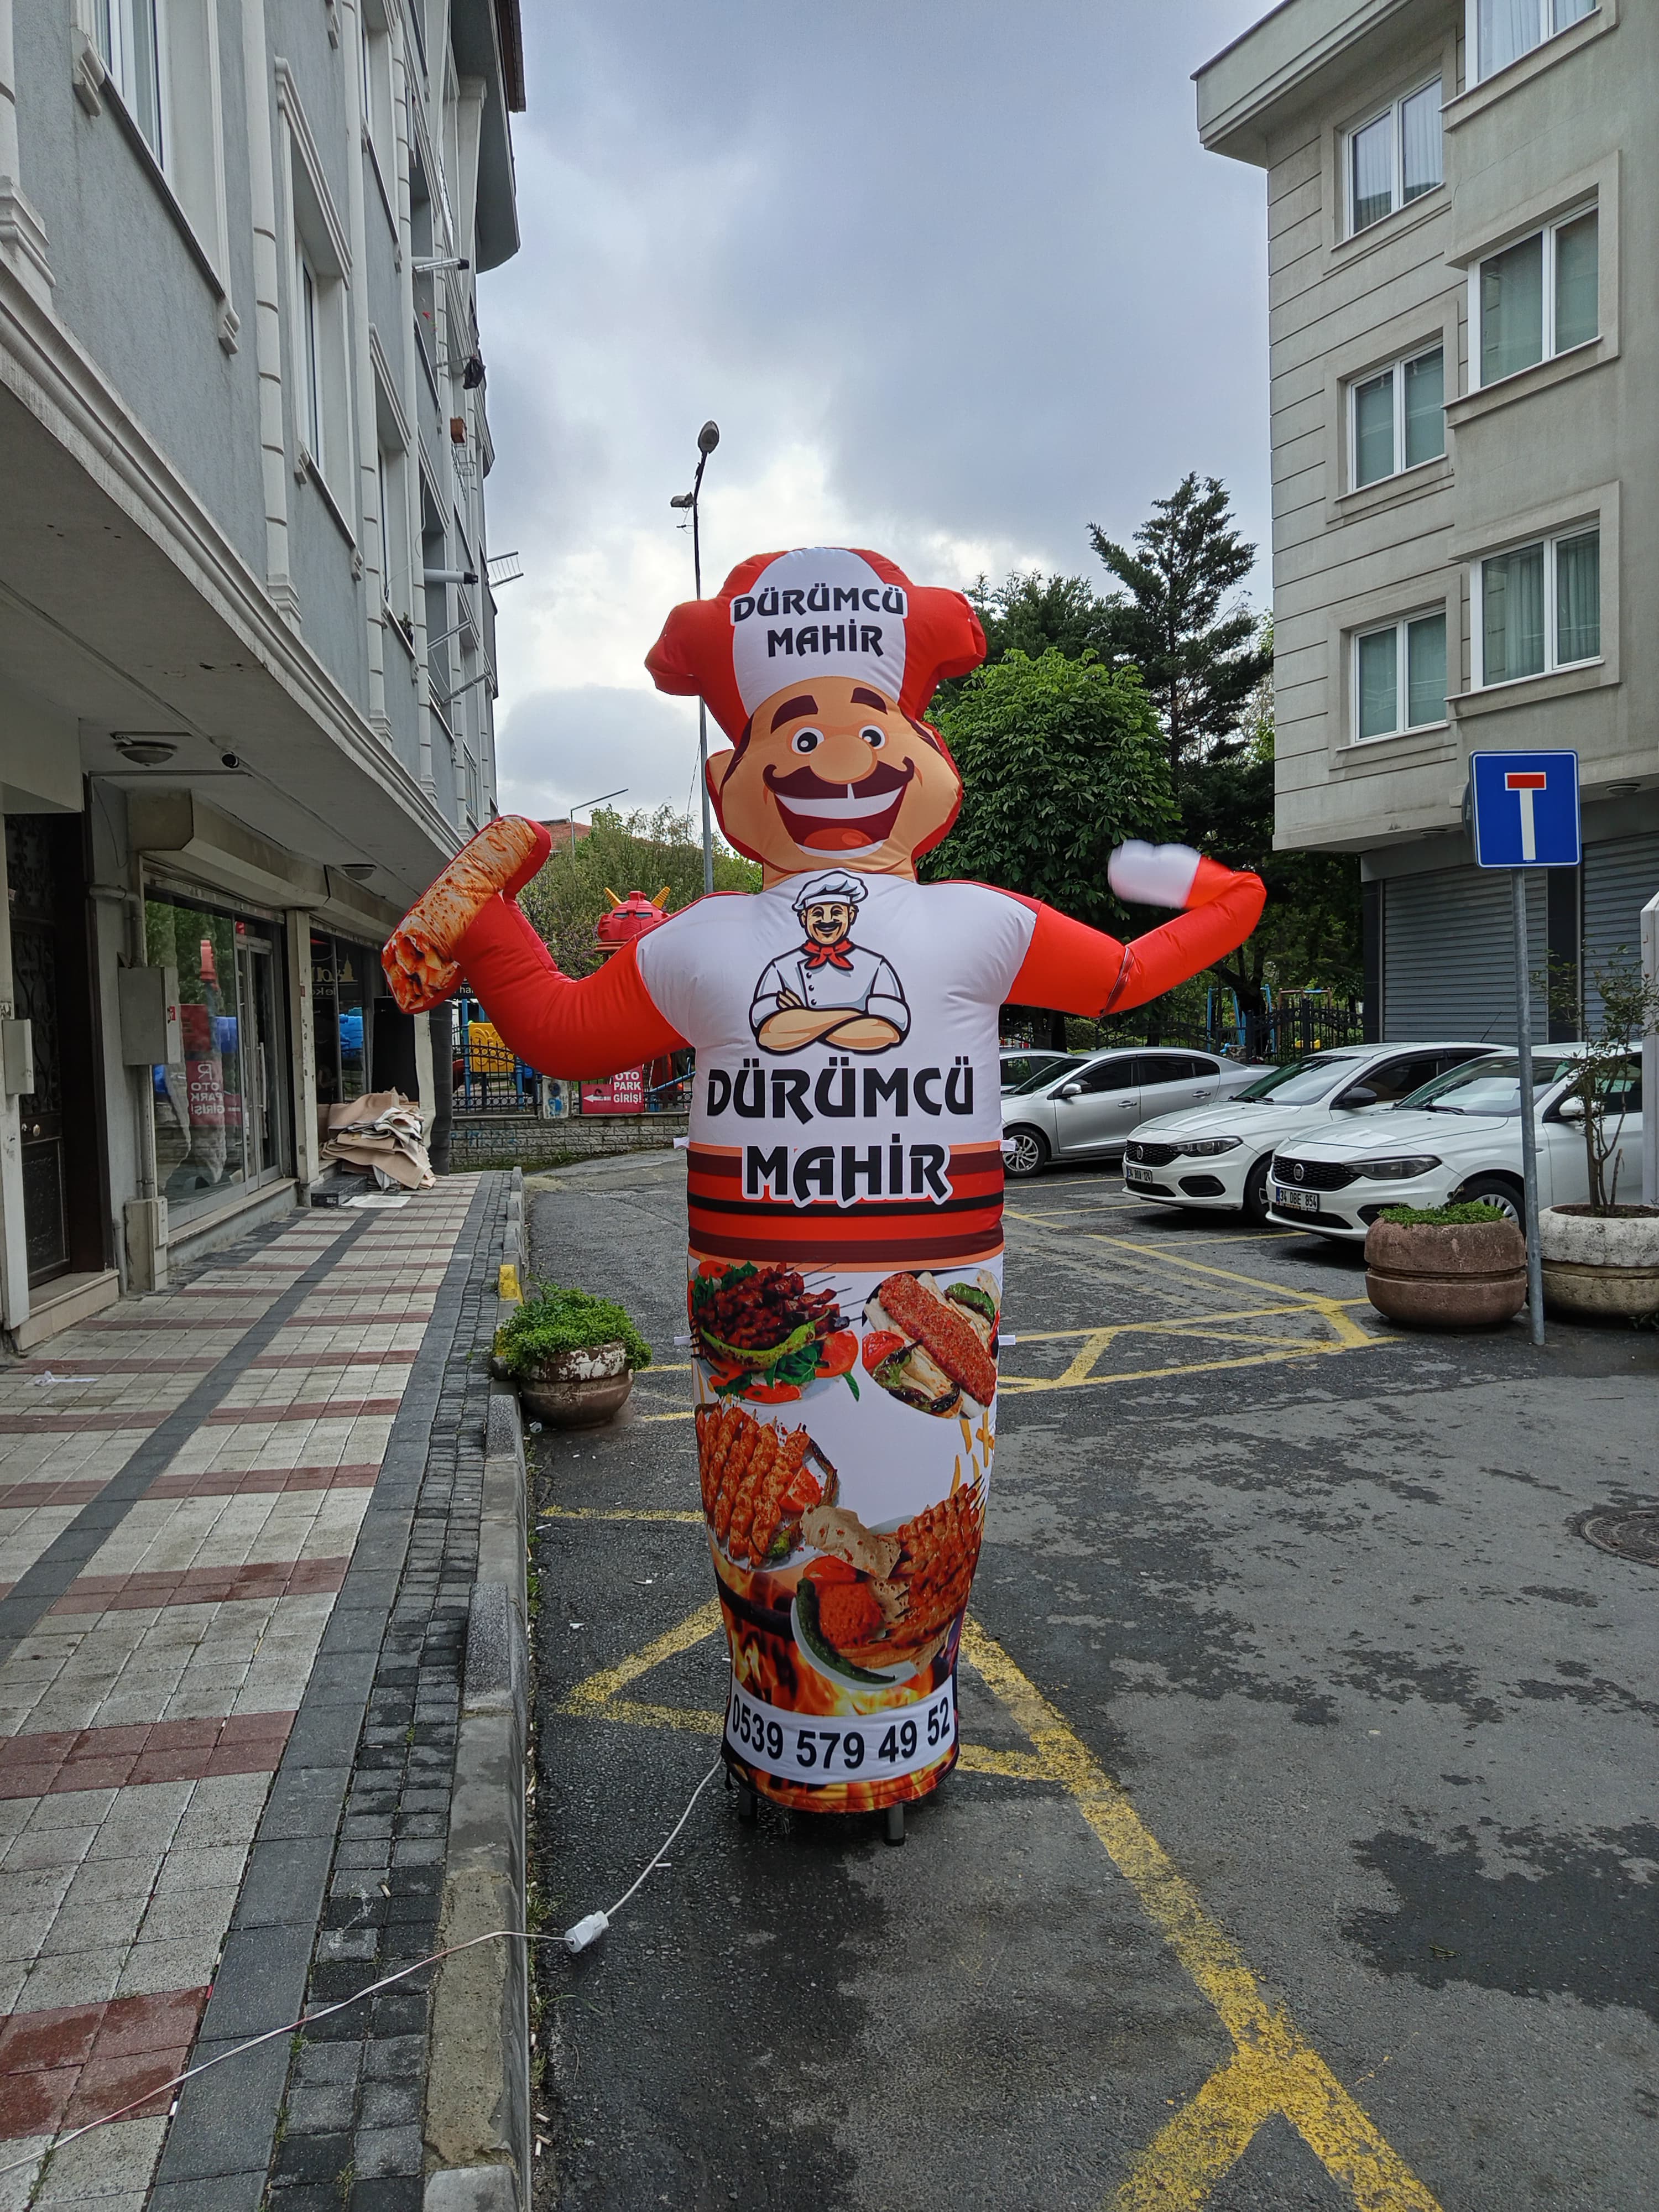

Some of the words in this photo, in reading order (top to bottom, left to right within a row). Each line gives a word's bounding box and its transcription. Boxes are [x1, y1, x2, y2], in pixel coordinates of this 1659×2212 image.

[733, 582, 904, 623] DÜRÜMCÜ
[767, 618, 884, 658] MAHİR
[613, 1082, 641, 1091] PARK
[615, 1071, 640, 1081] OTO
[706, 1056, 974, 1125] DÜRÜMCÜ
[613, 1092, 642, 1104] GİRİŞ!
[747, 1133, 948, 1202] MAHİR
[1280, 1190, 1287, 1202] 34
[1305, 1194, 1317, 1208] 854
[732, 1693, 784, 1760] 0539
[796, 1729, 865, 1769] 579
[878, 1719, 917, 1763] 49
[927, 1696, 951, 1746] 52
